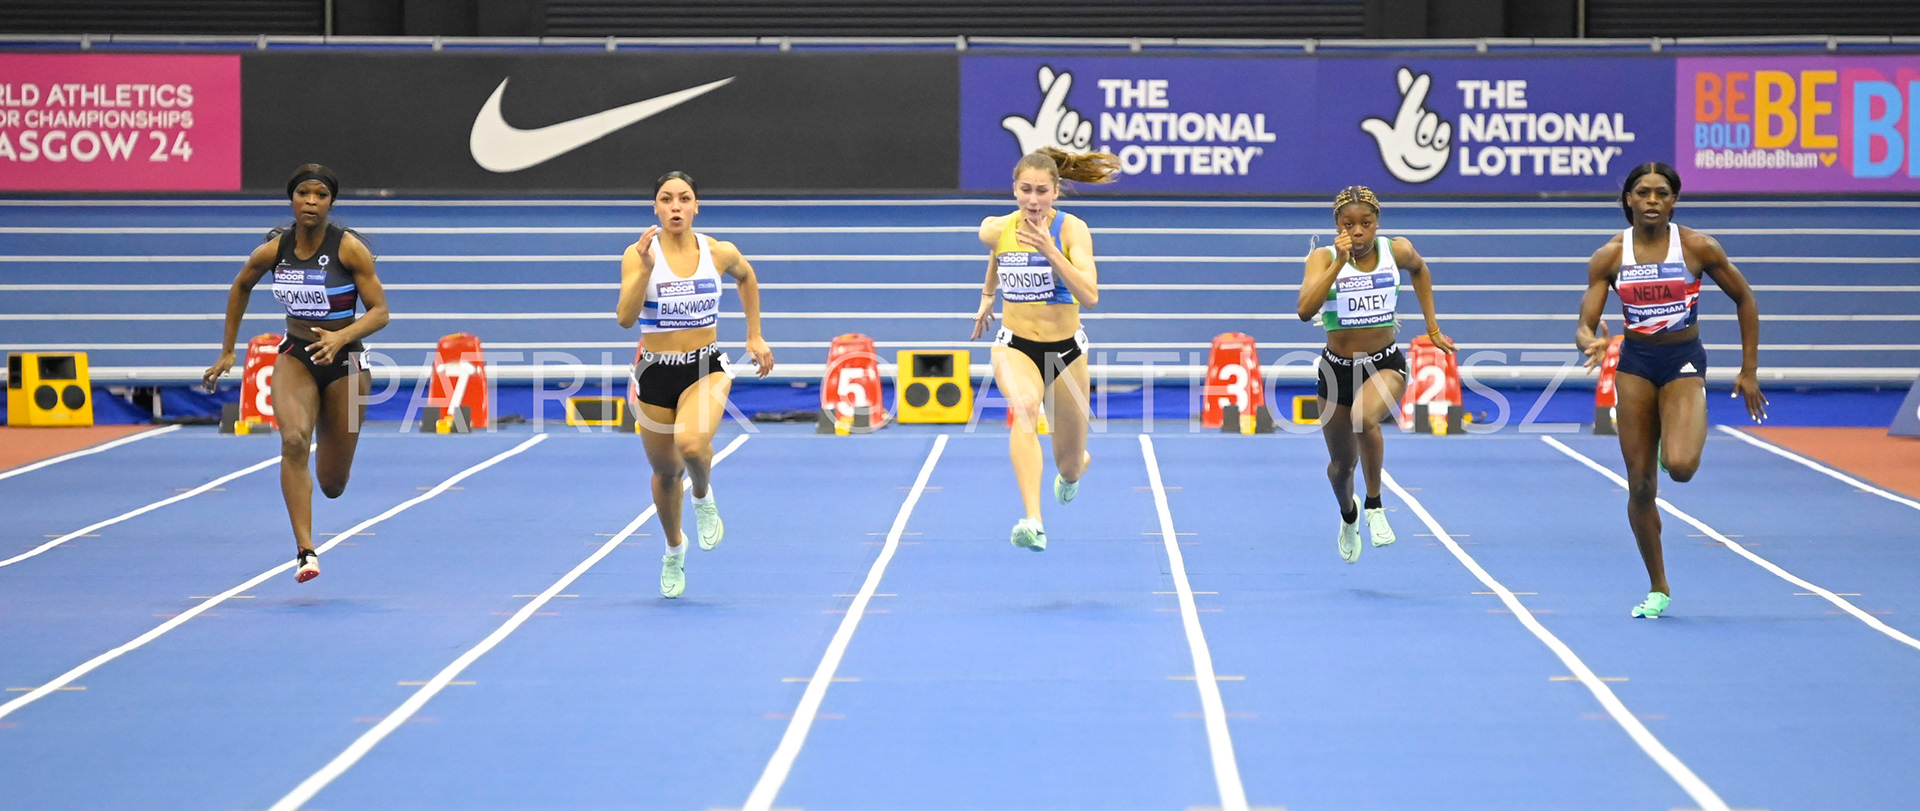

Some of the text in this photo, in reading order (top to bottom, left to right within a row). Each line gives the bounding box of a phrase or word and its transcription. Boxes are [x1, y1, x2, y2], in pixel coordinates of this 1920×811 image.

[46, 83, 194, 107] ATHLETICS
[1098, 79, 1169, 108] THE
[1457, 80, 1527, 109] THE
[1695, 72, 1749, 122] BE
[1755, 70, 1838, 148] BE
[25, 110, 193, 128] CHAMPIONSHIPS
[1101, 112, 1276, 142] NATIONAL
[1459, 113, 1635, 142] NATIONAL
[1695, 123, 1750, 148] BOLD
[149, 131, 193, 162] 24
[1694, 150, 1818, 169] #BeBoldBeBham
[1622, 268, 1658, 277] INDOOR
[660, 285, 695, 294] INDOOR
[1339, 280, 1373, 288] INDOOR
[1633, 285, 1672, 301] NEITA
[275, 289, 327, 304] SHOKUNBI
[1348, 293, 1388, 311] DATEY
[661, 298, 716, 315] BLACKWOOD
[1628, 304, 1684, 316] BIRMINGHAM
[660, 315, 714, 327] BIRMINGHAM
[1341, 313, 1393, 325] BIRMINGHAM
[658, 351, 696, 366] NIKE
[1326, 351, 1352, 366] NIKE
[1354, 352, 1384, 367] PRO
[441, 361, 475, 415] 7
[837, 367, 867, 418] 5
[1219, 364, 1248, 413] 3
[1416, 366, 1450, 414] 2
